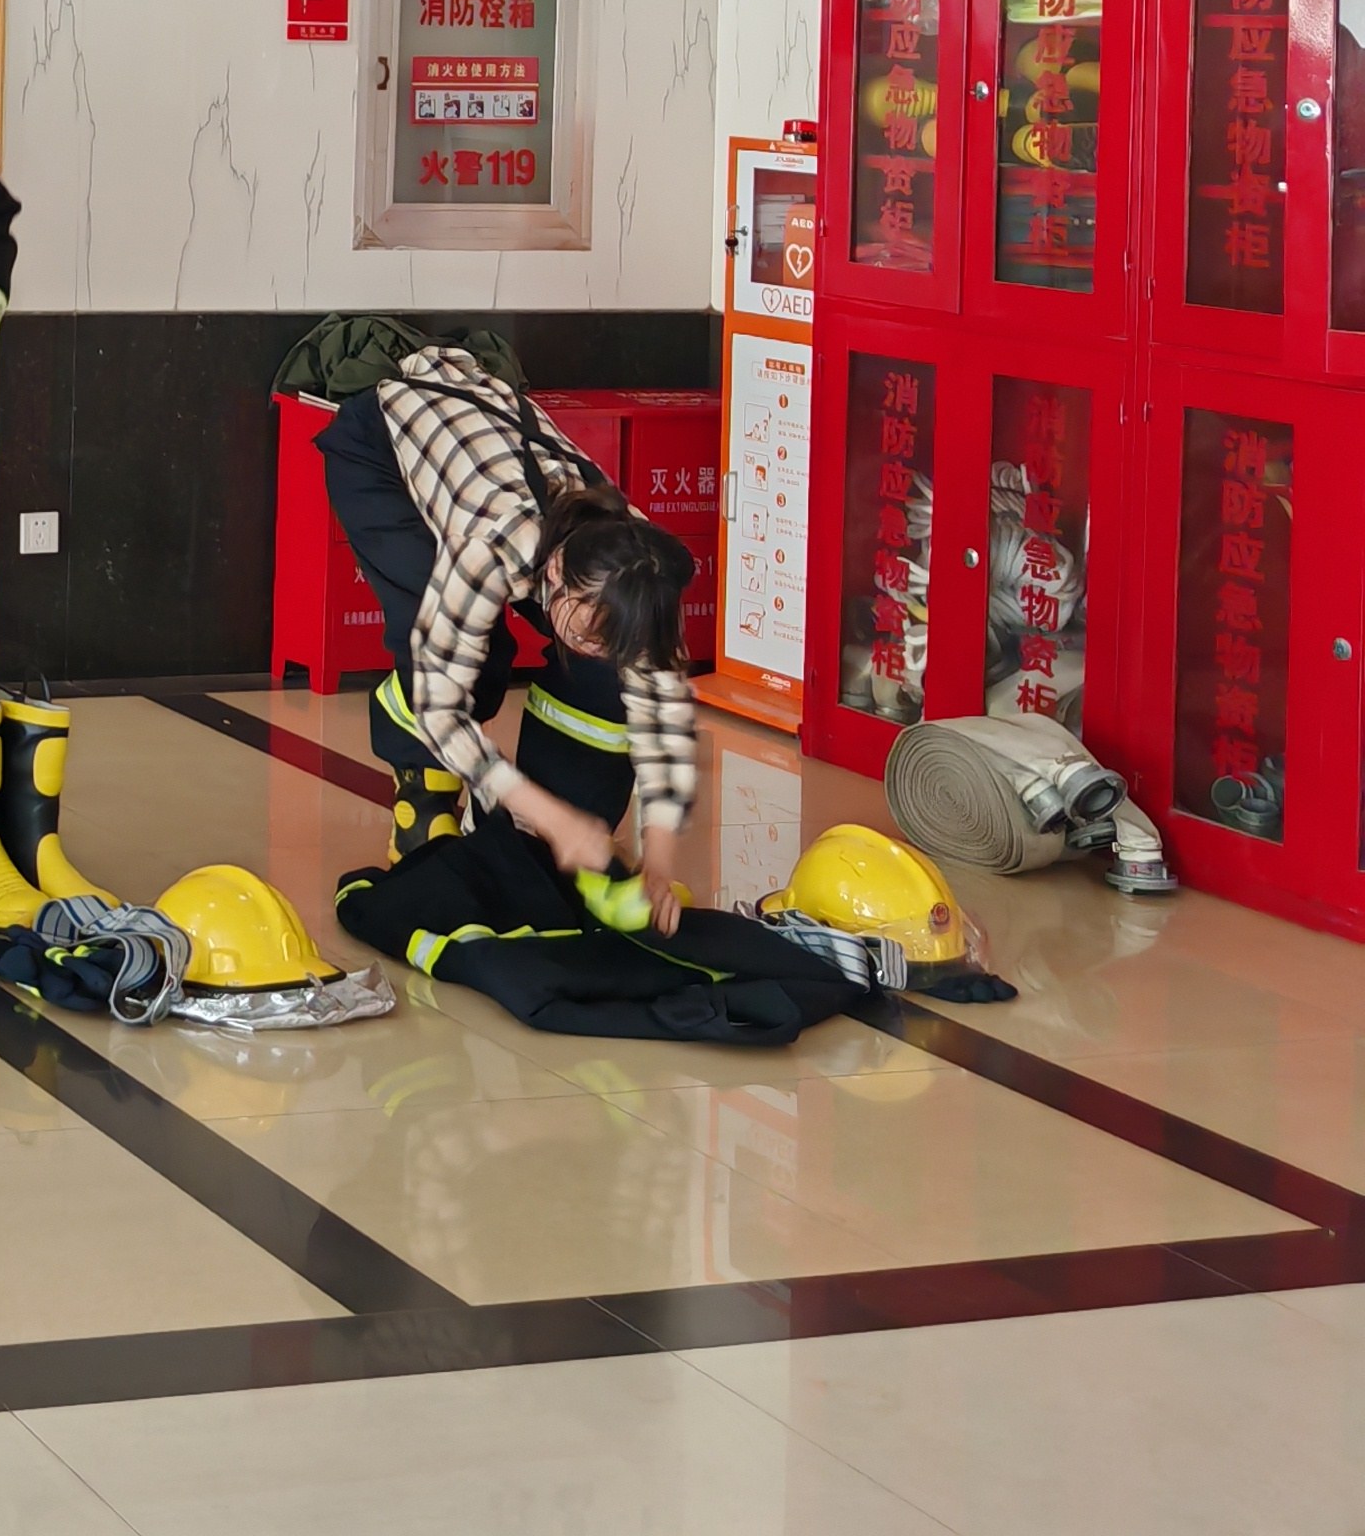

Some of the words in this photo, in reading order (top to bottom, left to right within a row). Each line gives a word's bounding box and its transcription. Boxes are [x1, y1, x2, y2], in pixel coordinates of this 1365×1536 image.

[791, 217, 814, 229] AED
[781, 294, 812, 315] AED
[650, 466, 716, 496] 灭火器
